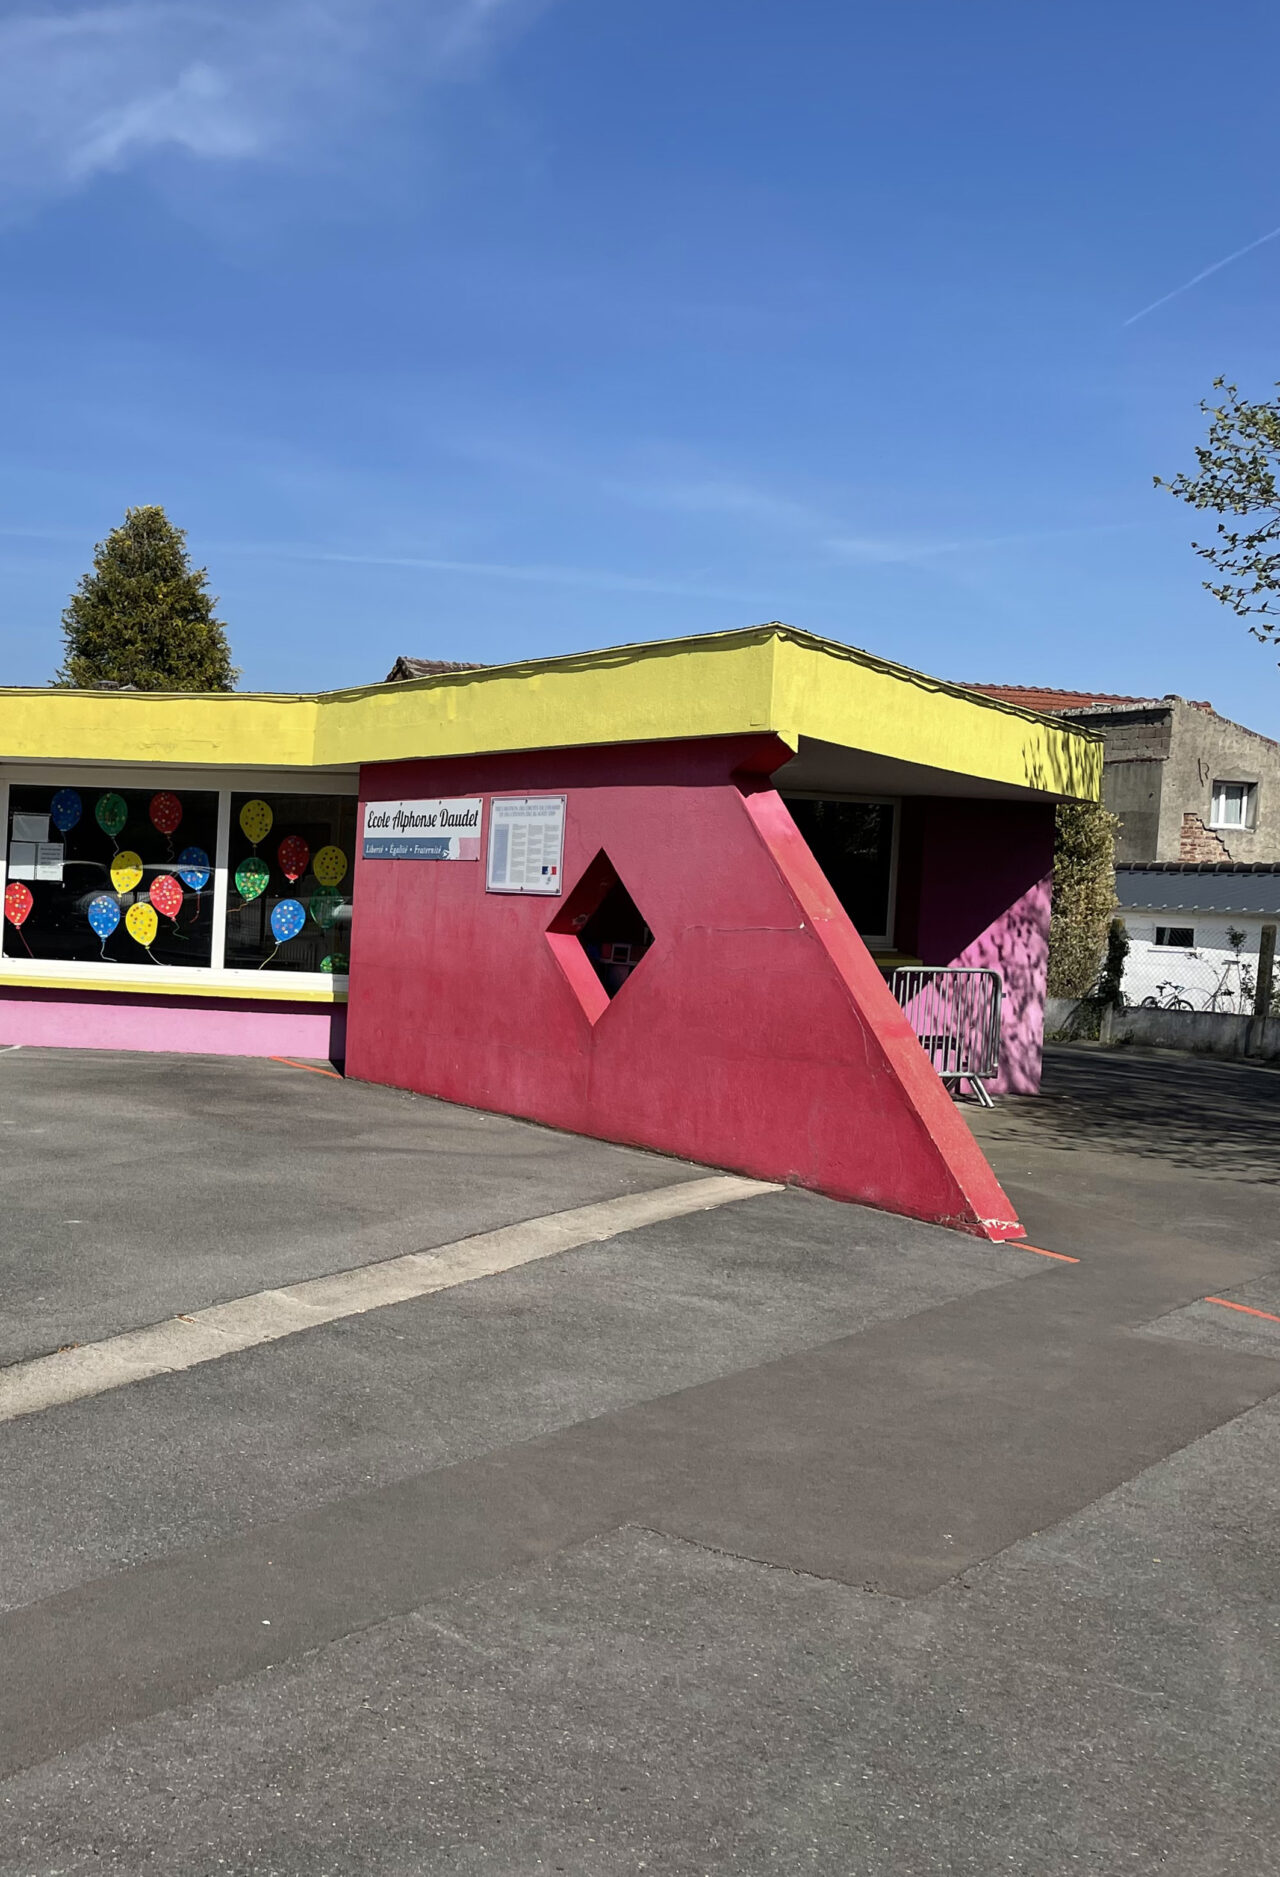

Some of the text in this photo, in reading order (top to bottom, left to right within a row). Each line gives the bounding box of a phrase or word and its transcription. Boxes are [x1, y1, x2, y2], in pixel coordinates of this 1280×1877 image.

[367, 808, 479, 833] Ecole Alphonse Daudet
[413, 843, 442, 854] Fraternité
